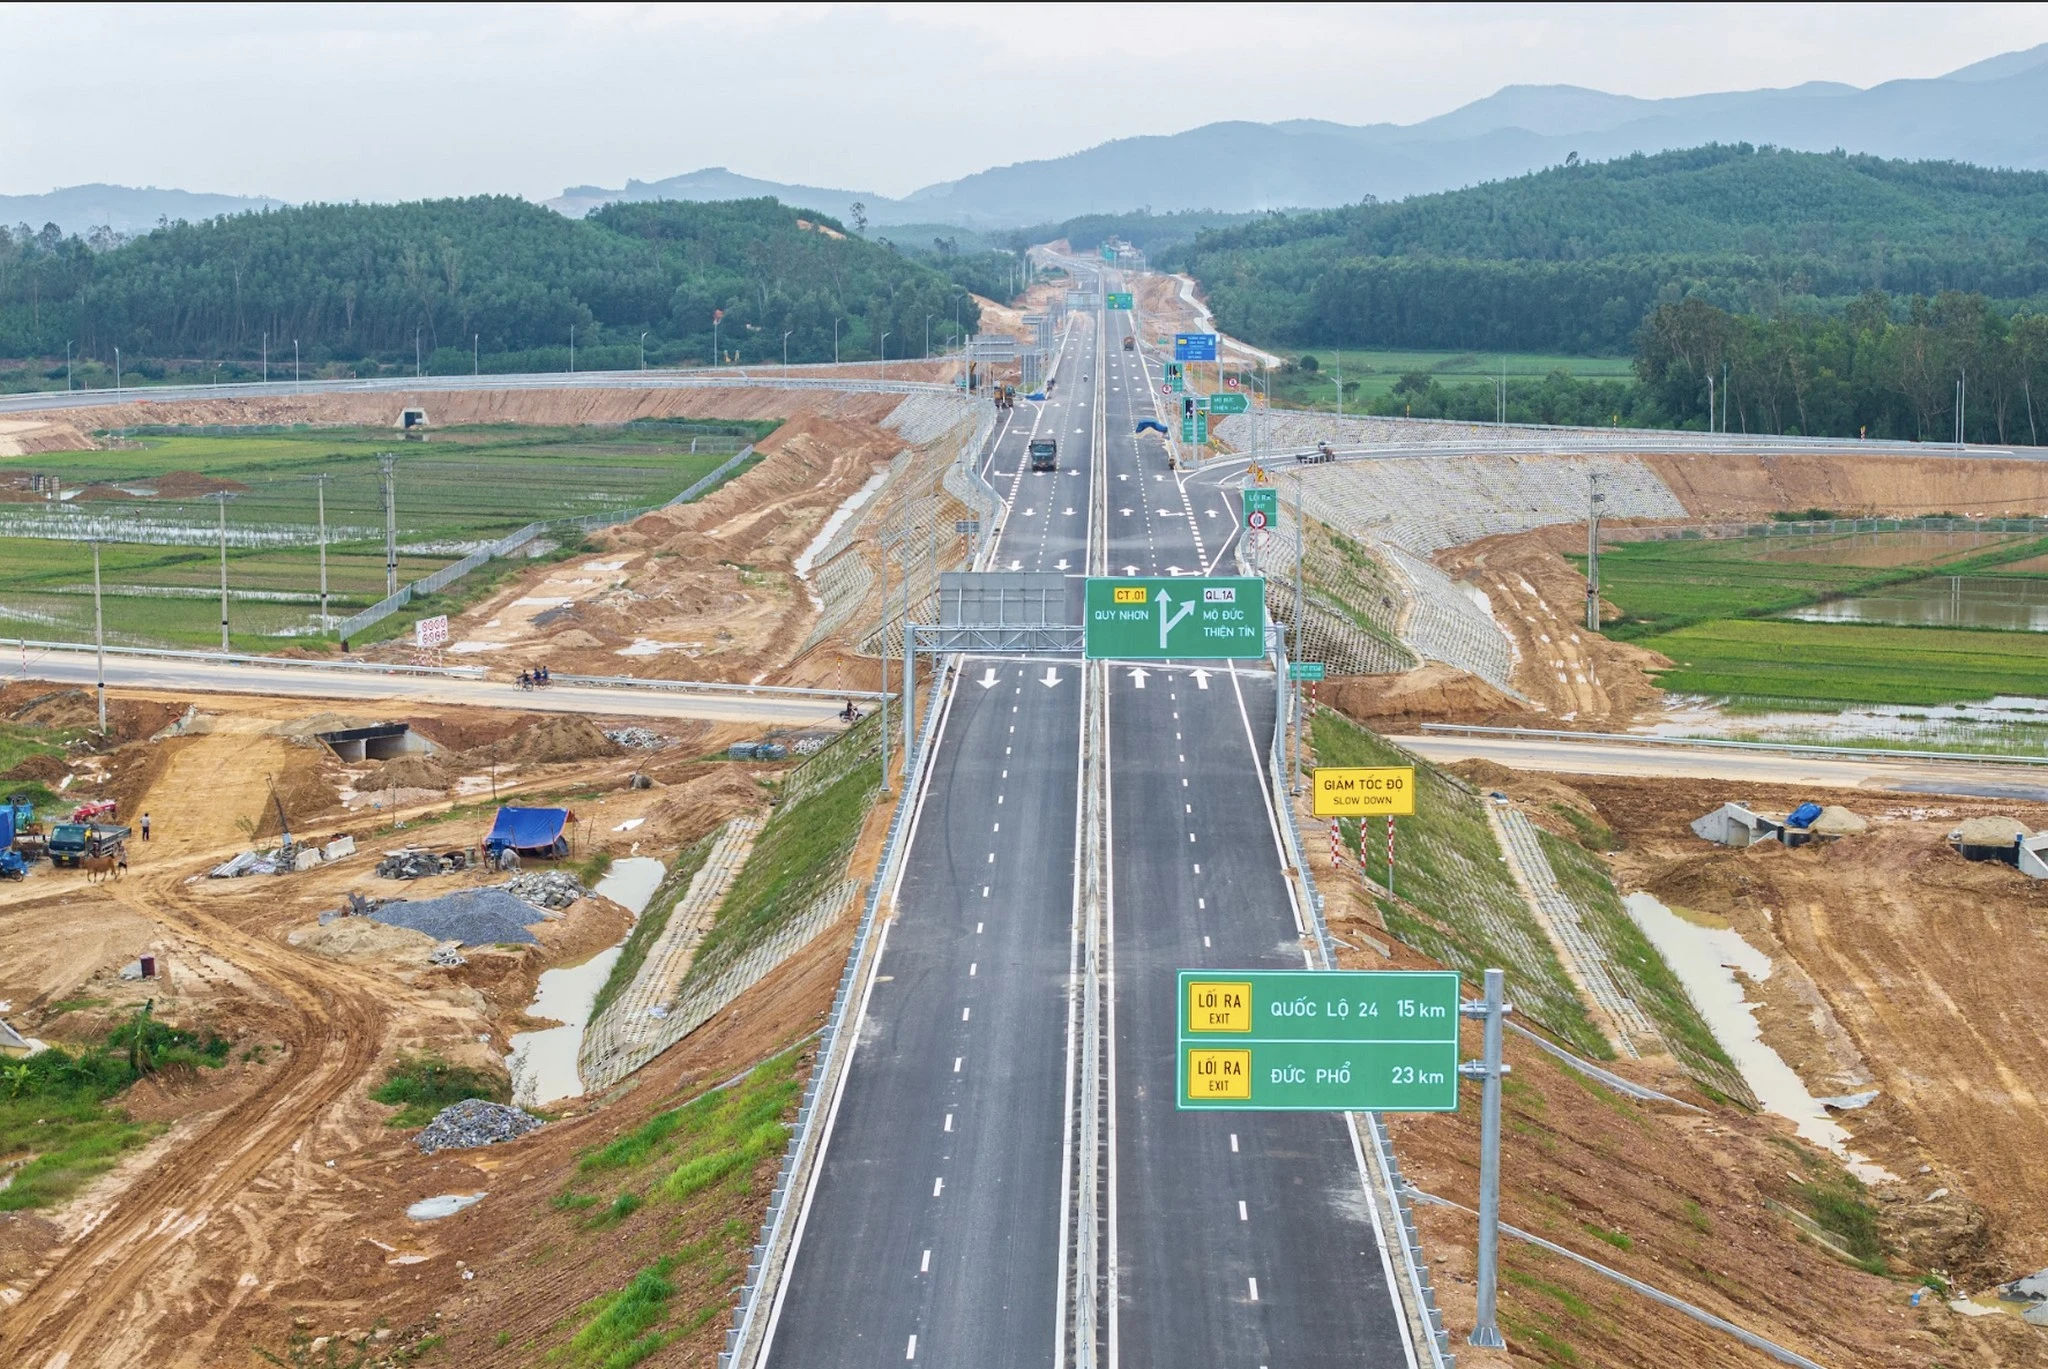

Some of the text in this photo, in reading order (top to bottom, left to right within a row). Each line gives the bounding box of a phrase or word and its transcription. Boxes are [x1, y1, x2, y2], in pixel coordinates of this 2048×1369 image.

[1116, 590, 1144, 600] CT.01
[1205, 590, 1234, 600] QL.1A
[1095, 610, 1149, 620] QUY NHƠN
[1203, 607, 1244, 622] MỘ ĐỨC
[1203, 624, 1255, 639] THIỆN TÍN
[1324, 774, 1403, 792] GIẢM TỐC ĐỘ
[1333, 796, 1392, 805] SLOW DOWN
[1198, 988, 1242, 1008] LỐI RA
[1271, 995, 1446, 1020] QUỐC LỘ 24 15 km
[1209, 1013, 1230, 1024] EXIT
[1197, 1055, 1242, 1076] LỐI RA
[1270, 1061, 1444, 1084] ĐỨC PHỔ 23 km
[1208, 1080, 1229, 1092] EXIT
